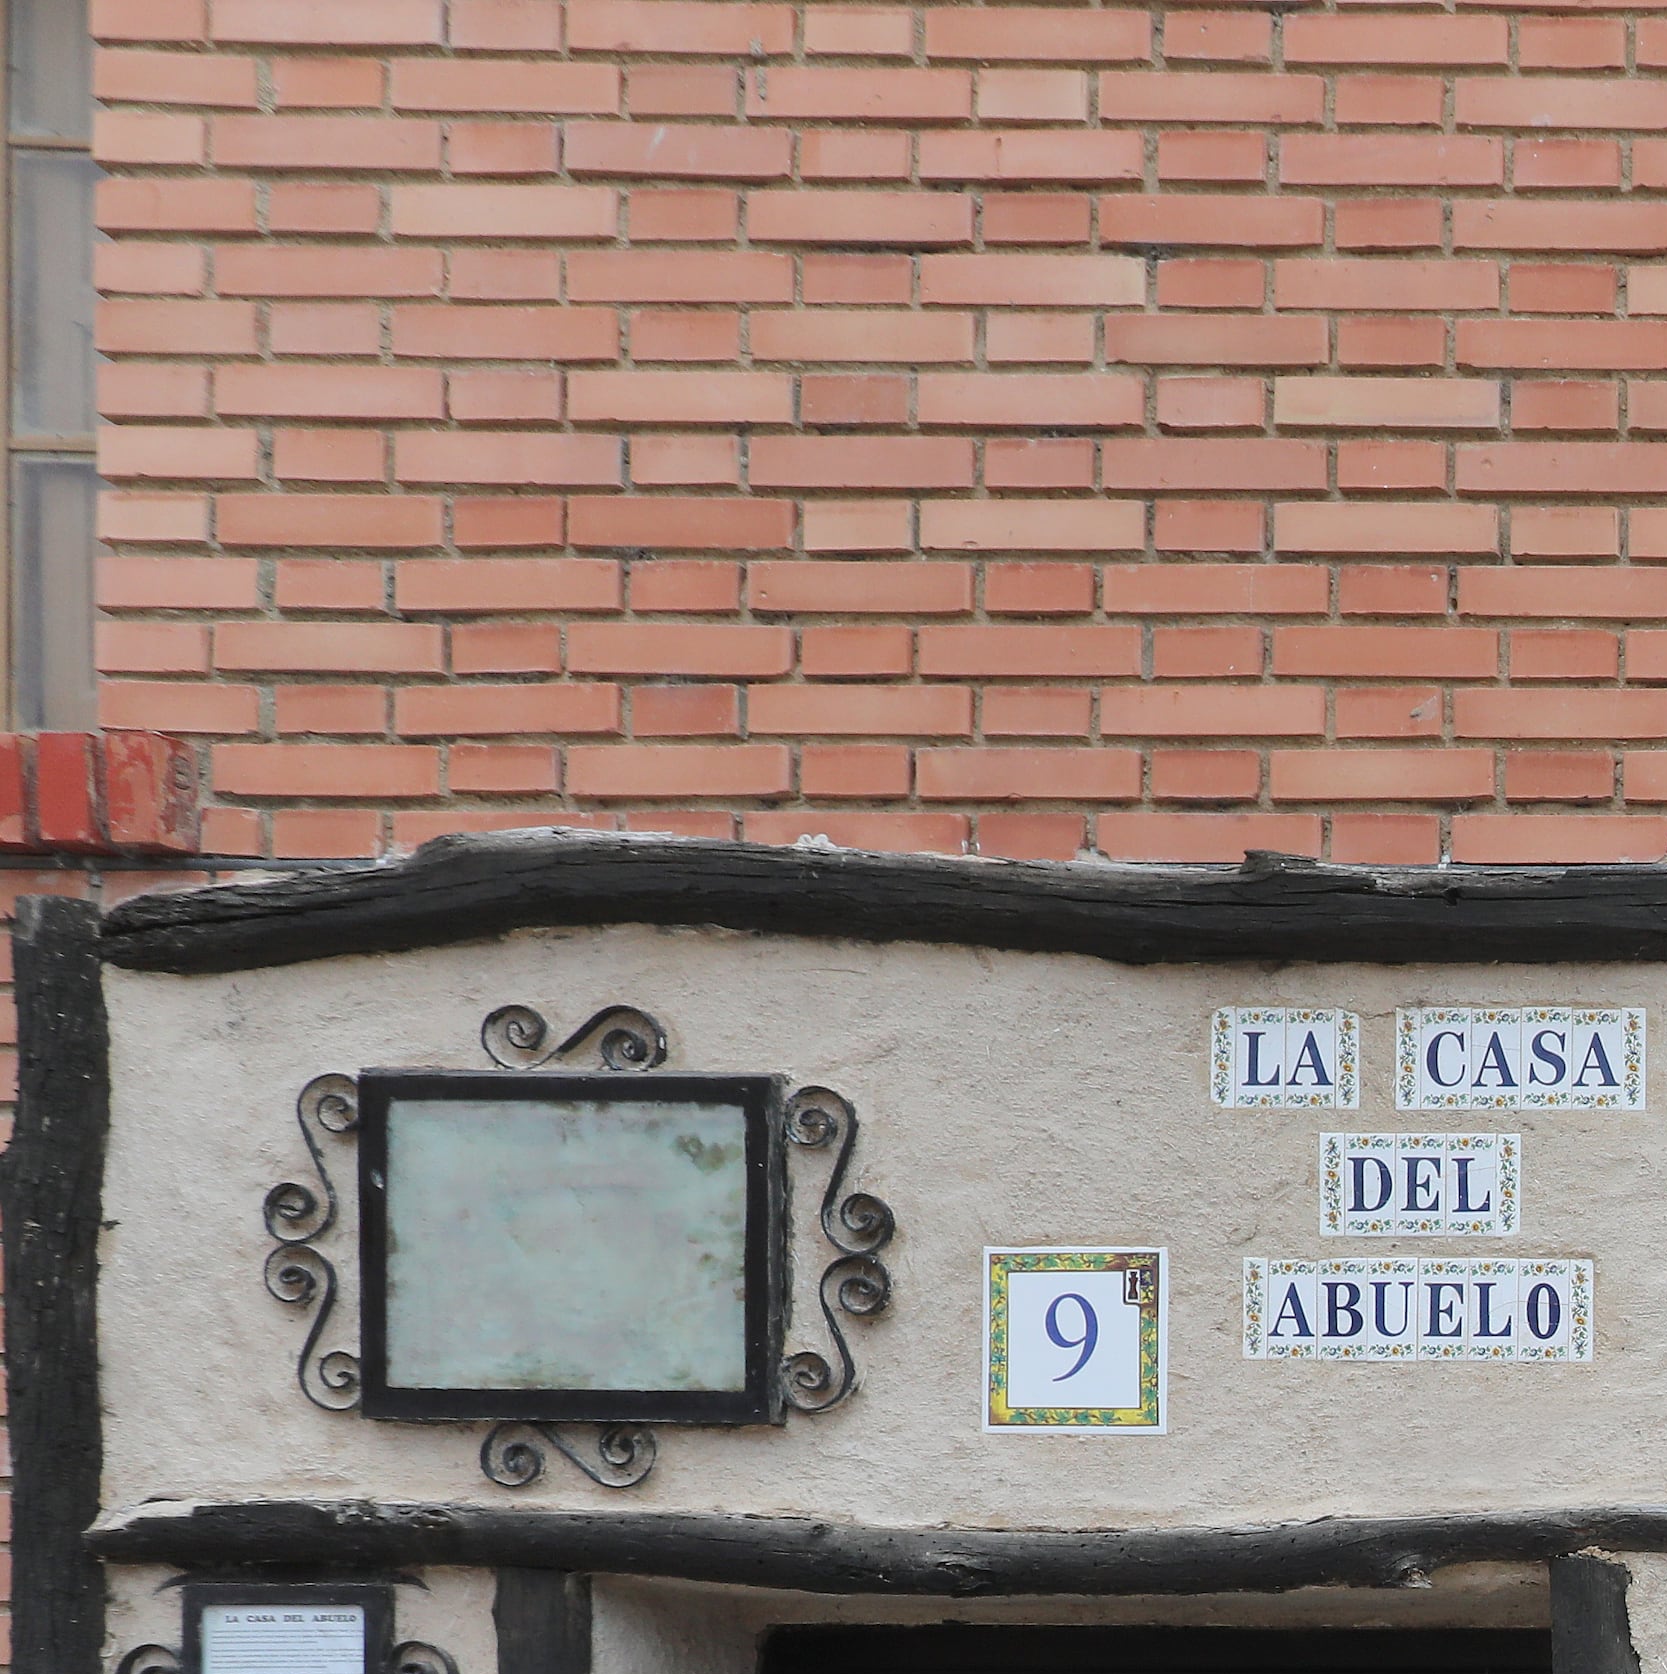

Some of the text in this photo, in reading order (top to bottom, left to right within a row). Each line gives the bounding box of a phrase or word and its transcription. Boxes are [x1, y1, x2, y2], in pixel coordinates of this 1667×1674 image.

[1242, 1029, 1620, 1087] LA CASA
[1348, 1157, 1491, 1212] DEL
[1045, 1293, 1099, 1382] 9
[1268, 1281, 1561, 1340] ABUELO
[225, 1614, 357, 1623] LA CASA DEL ABUELO
